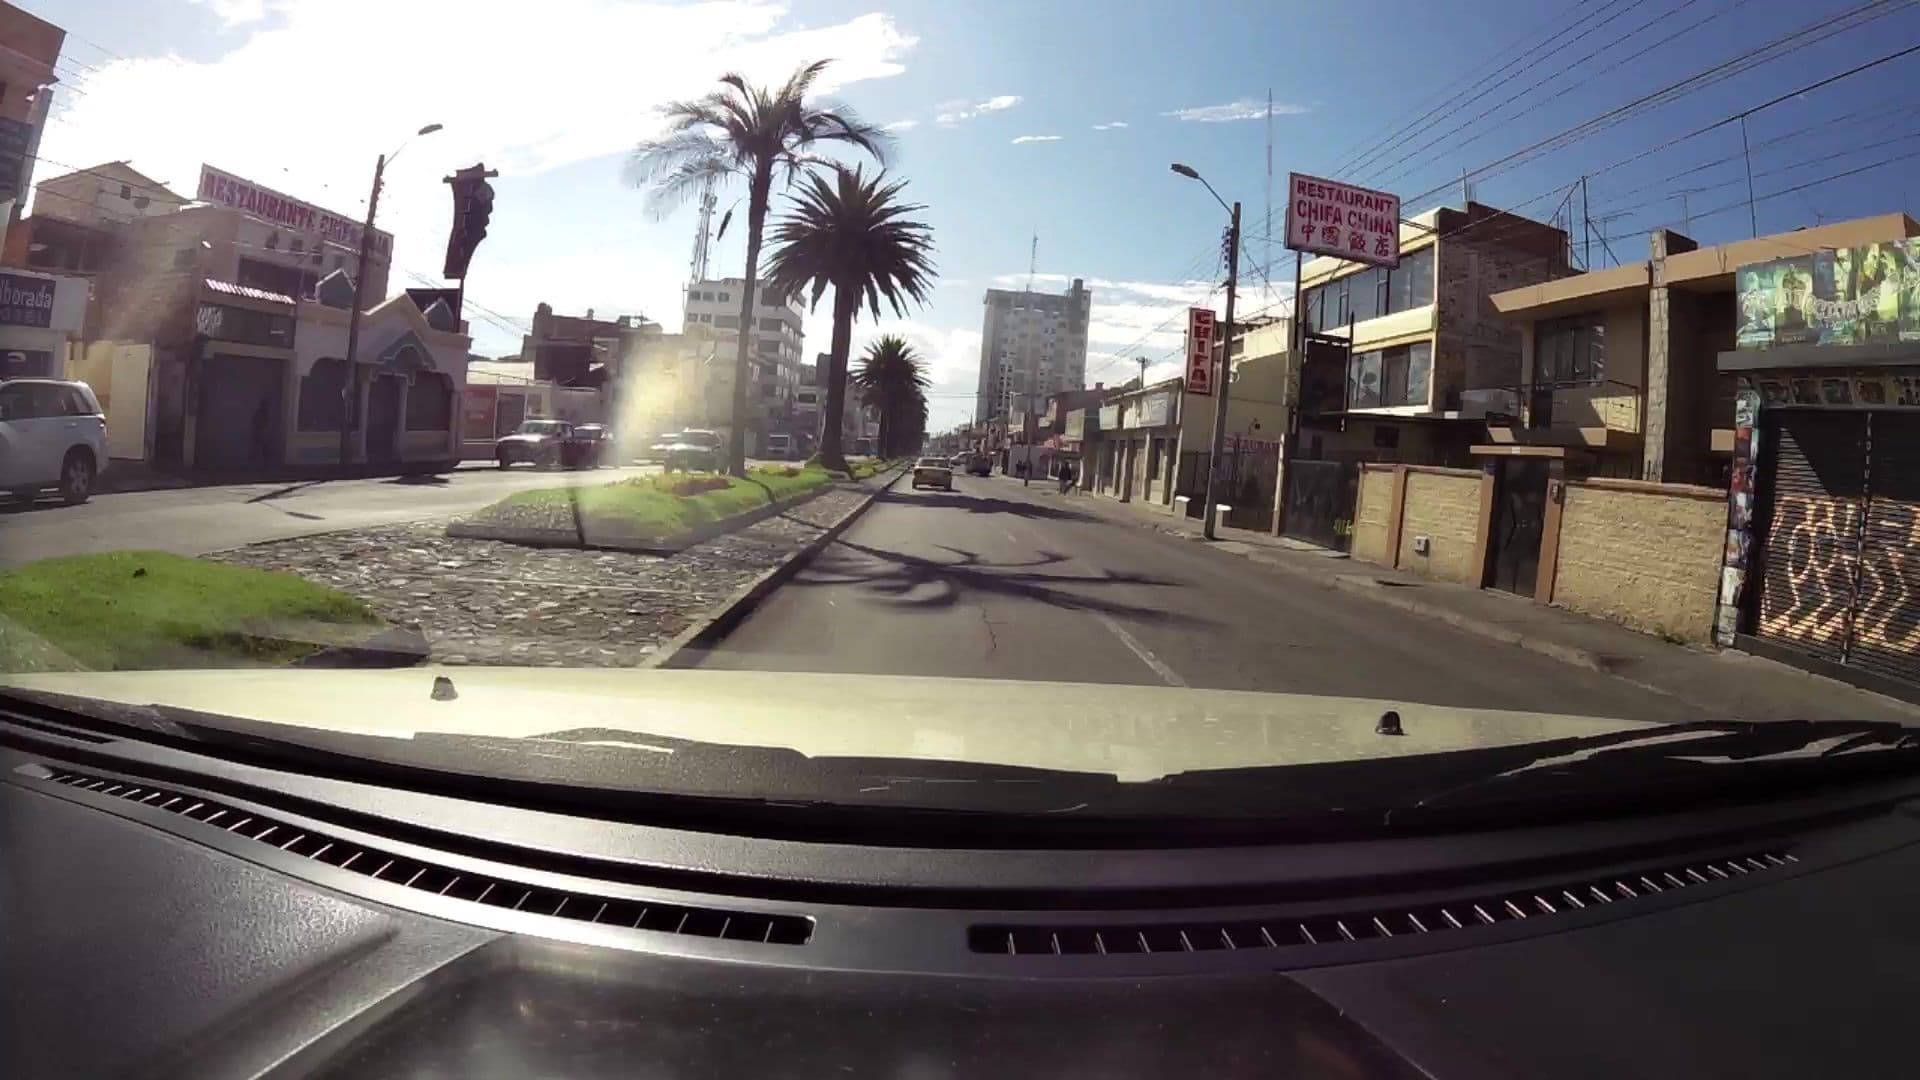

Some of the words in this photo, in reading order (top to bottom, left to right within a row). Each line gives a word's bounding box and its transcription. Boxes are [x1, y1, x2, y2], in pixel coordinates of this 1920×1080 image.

[1297, 180, 1392, 212] RESTAURANT
[1297, 200, 1342, 226] CHIFA
[1348, 210, 1393, 237] CHINA
[1191, 311, 1211, 382] CHIFA
